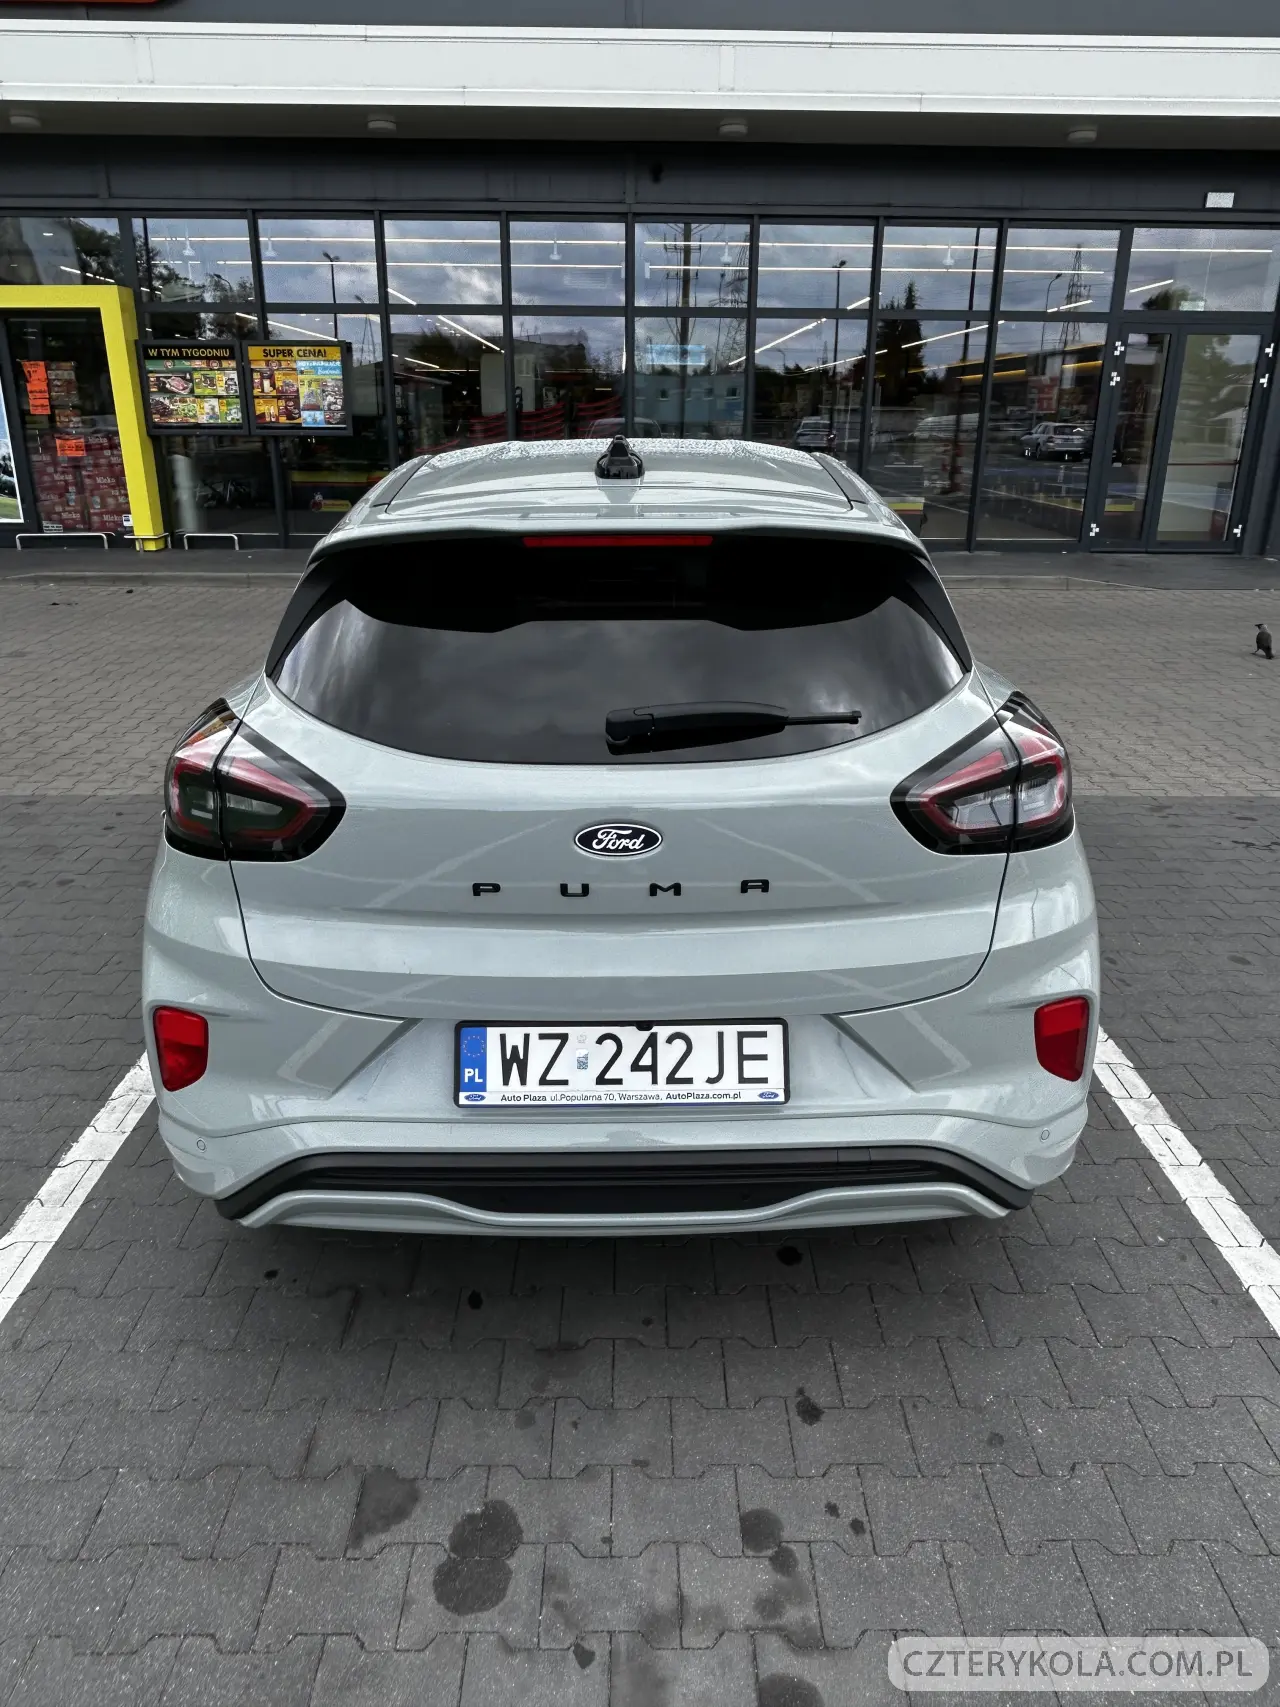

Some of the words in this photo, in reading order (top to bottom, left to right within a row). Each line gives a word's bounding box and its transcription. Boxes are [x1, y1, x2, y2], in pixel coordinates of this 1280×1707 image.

[148, 348, 158, 357] W
[160, 348, 180, 357] TYM
[182, 348, 230, 357] TYGODNIU
[263, 348, 294, 358] SUPER
[296, 348, 327, 358] CENA!
[592, 828, 645, 850] Ford
[472, 879, 770, 897] PUMA
[500, 1033, 569, 1086] WZ
[595, 1031, 769, 1086] 242JE
[464, 1068, 483, 1083] PL
[500, 1093, 522, 1102] Auto
[523, 1093, 547, 1102] Plaza
[618, 1092, 663, 1101] Warszawa,
[665, 1092, 742, 1100] AutoPlaza.com.pl
